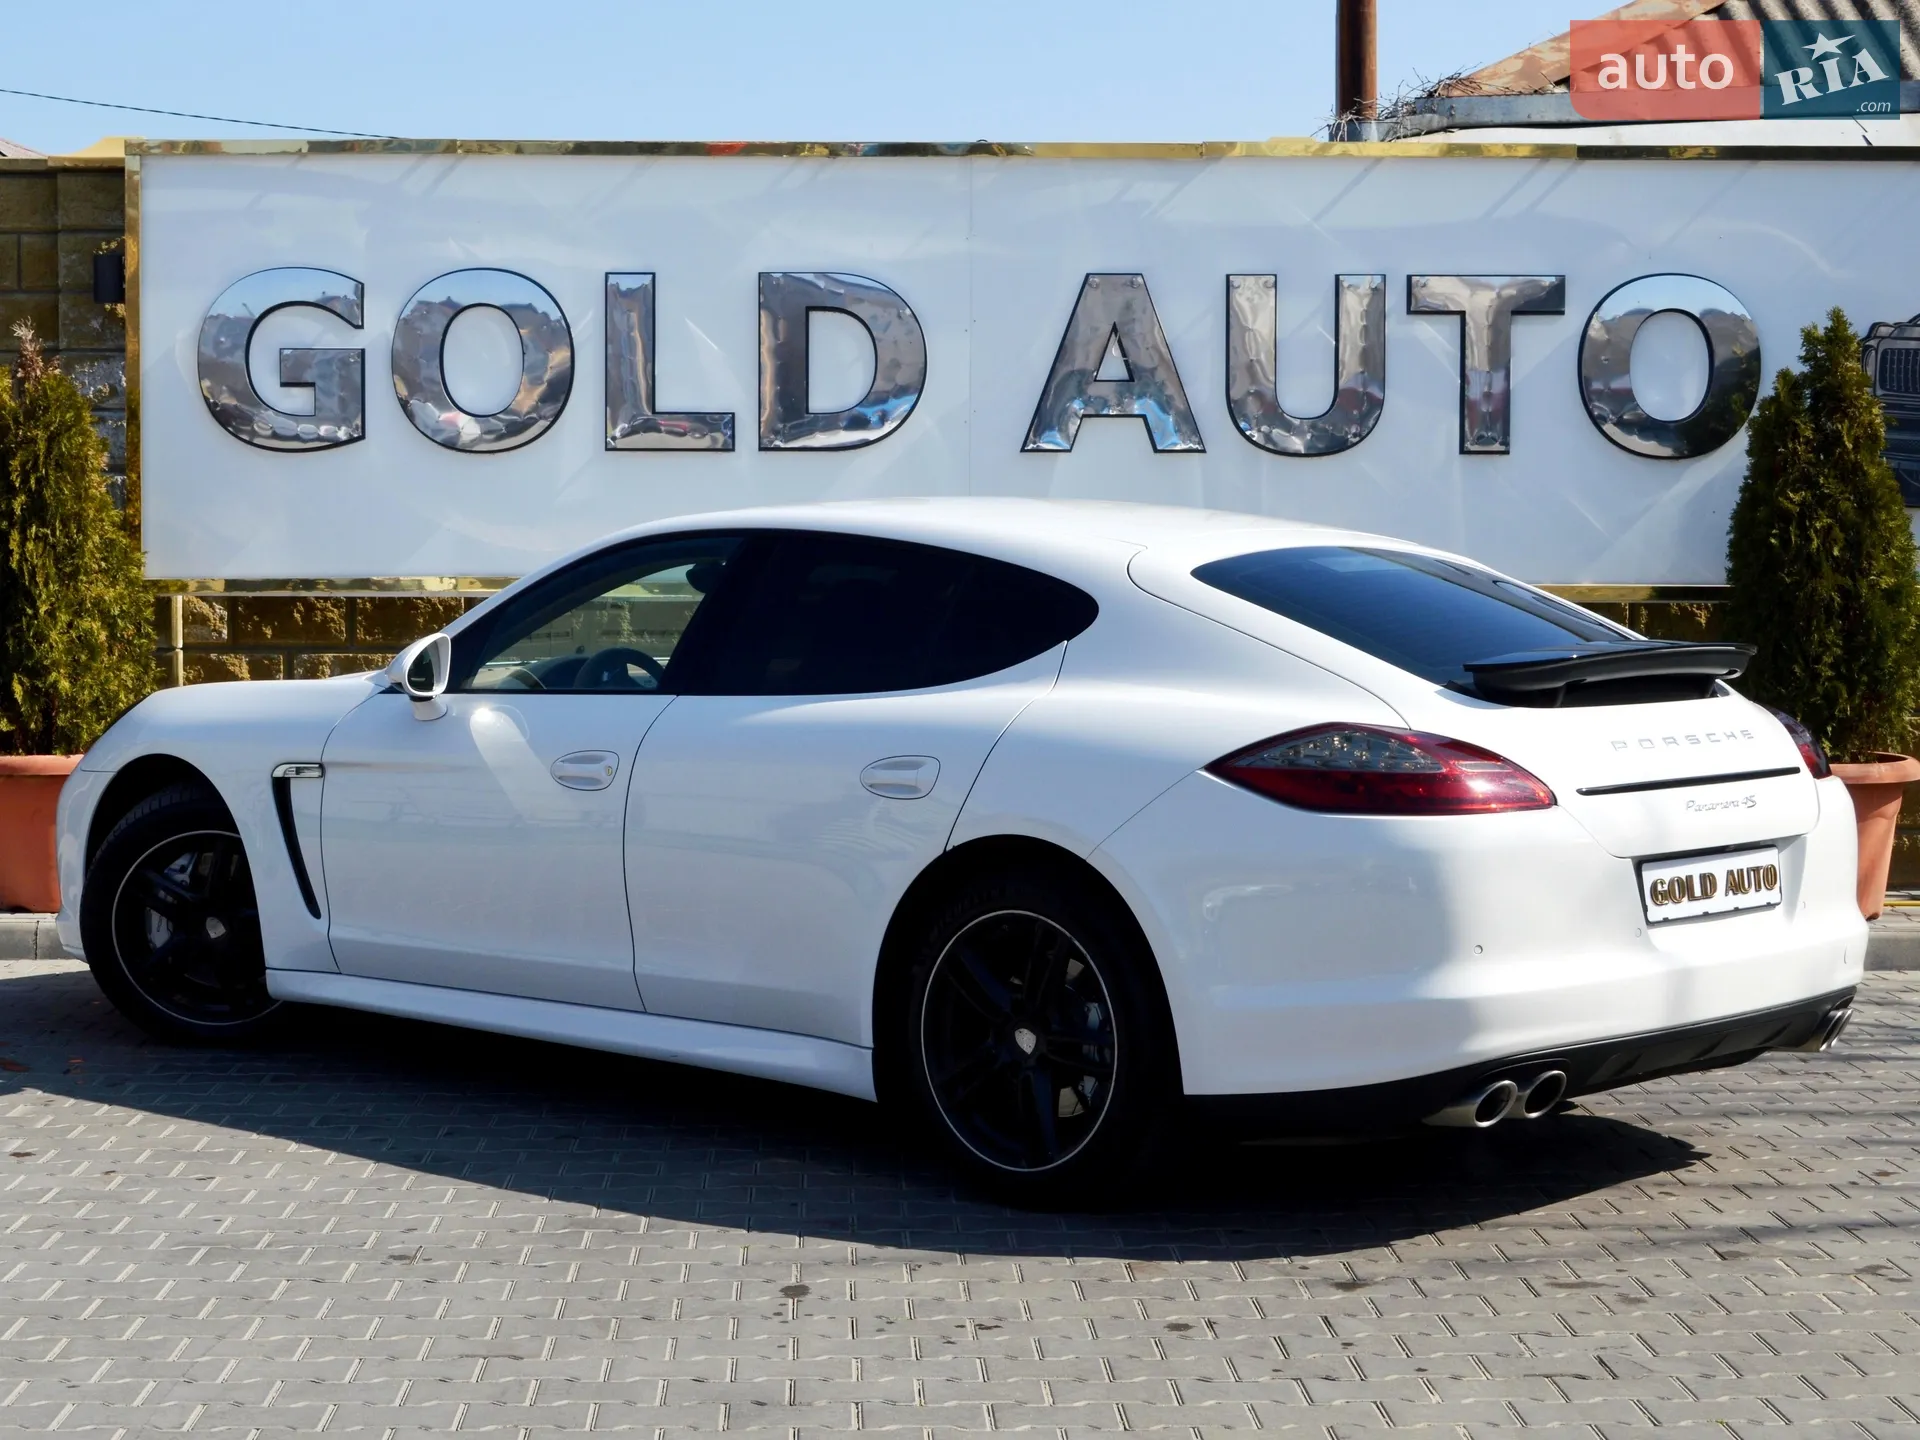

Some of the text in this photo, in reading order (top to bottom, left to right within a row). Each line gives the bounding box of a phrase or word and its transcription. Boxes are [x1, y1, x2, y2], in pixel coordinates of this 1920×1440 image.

[197, 267, 1762, 460] GOLD AUTO
[1610, 729, 1755, 751] PORSCHE
[1650, 864, 1778, 906] GOLD AUTO
